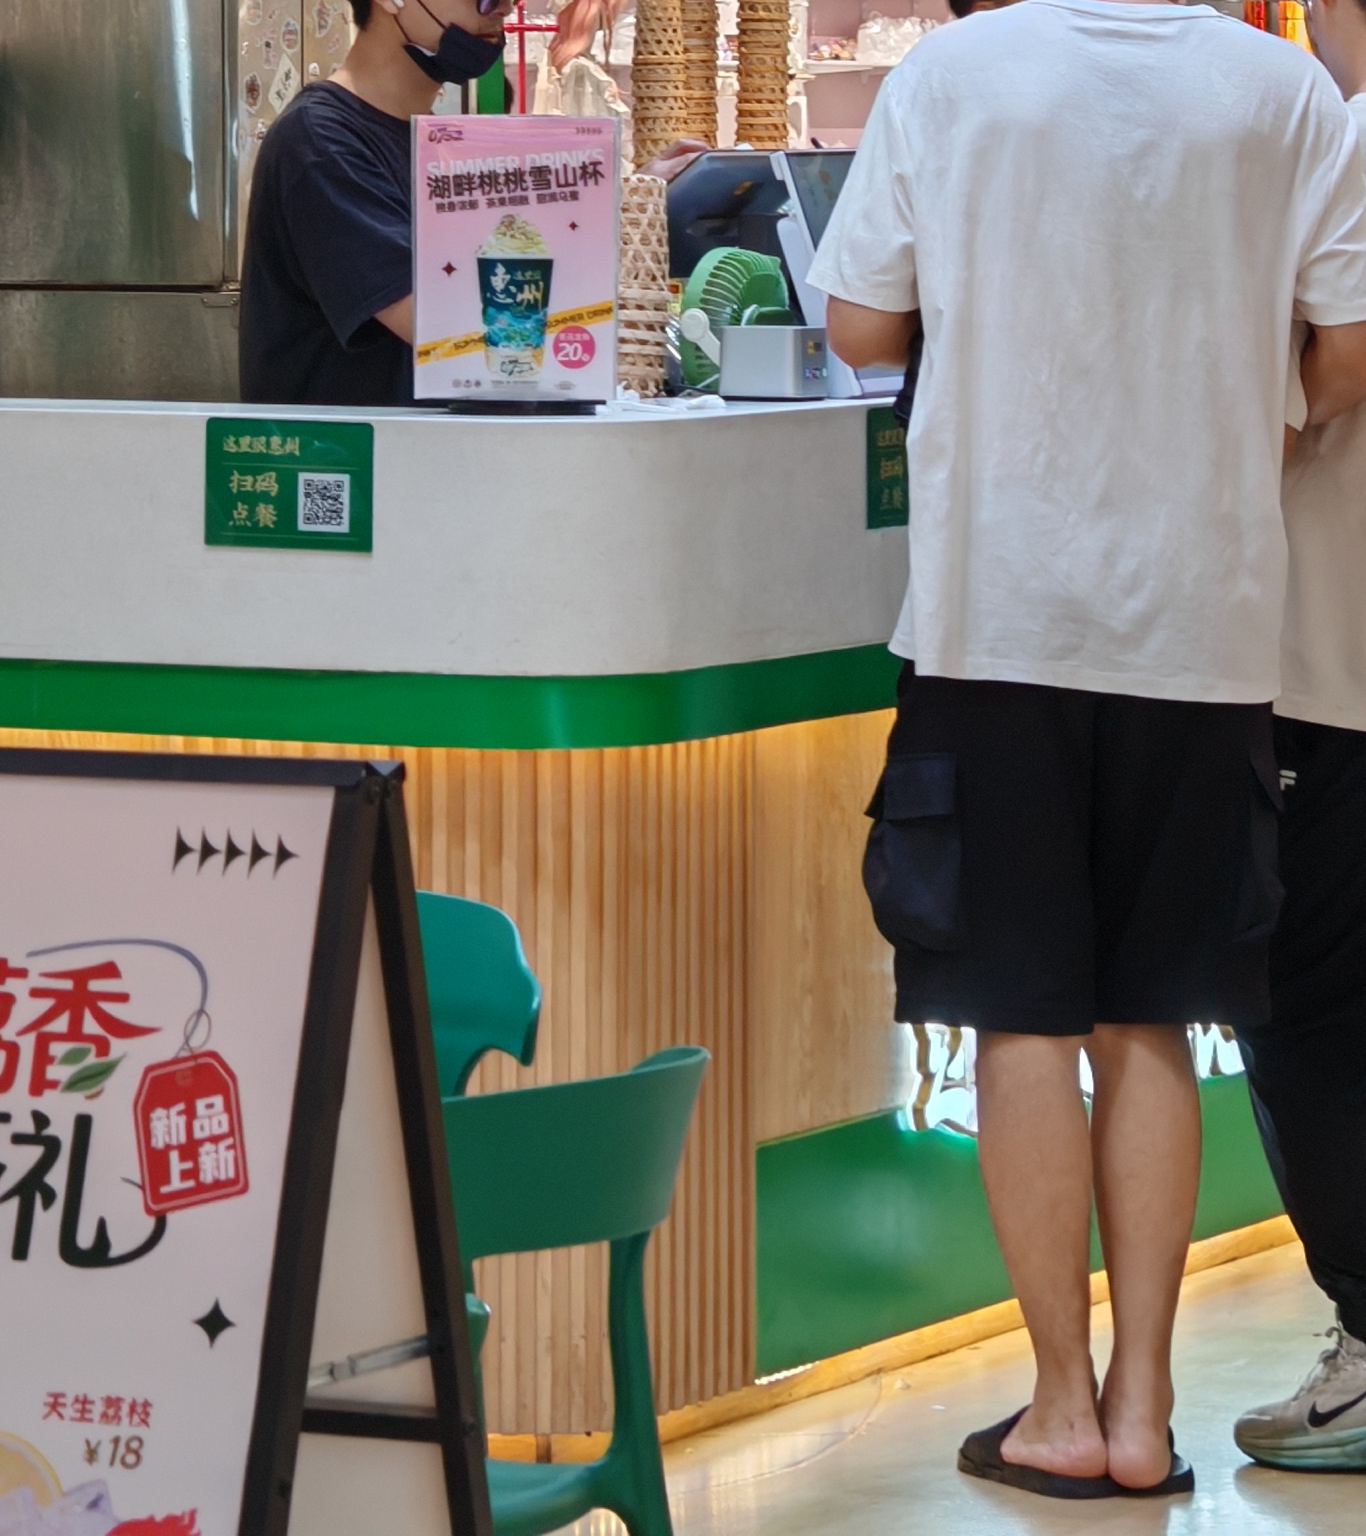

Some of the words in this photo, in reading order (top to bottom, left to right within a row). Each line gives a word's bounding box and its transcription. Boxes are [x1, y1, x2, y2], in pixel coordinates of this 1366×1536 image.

[426, 160, 605, 201] 湖畔桃桃雪山杯
[556, 343, 582, 361] 20
[229, 470, 279, 497] 扫码
[228, 502, 278, 528] 点餐
[150, 1094, 229, 1150] 新品
[160, 1137, 236, 1195] 上新
[42, 1391, 153, 1428] 天生荔枝
[84, 1434, 144, 1470] ¥18
